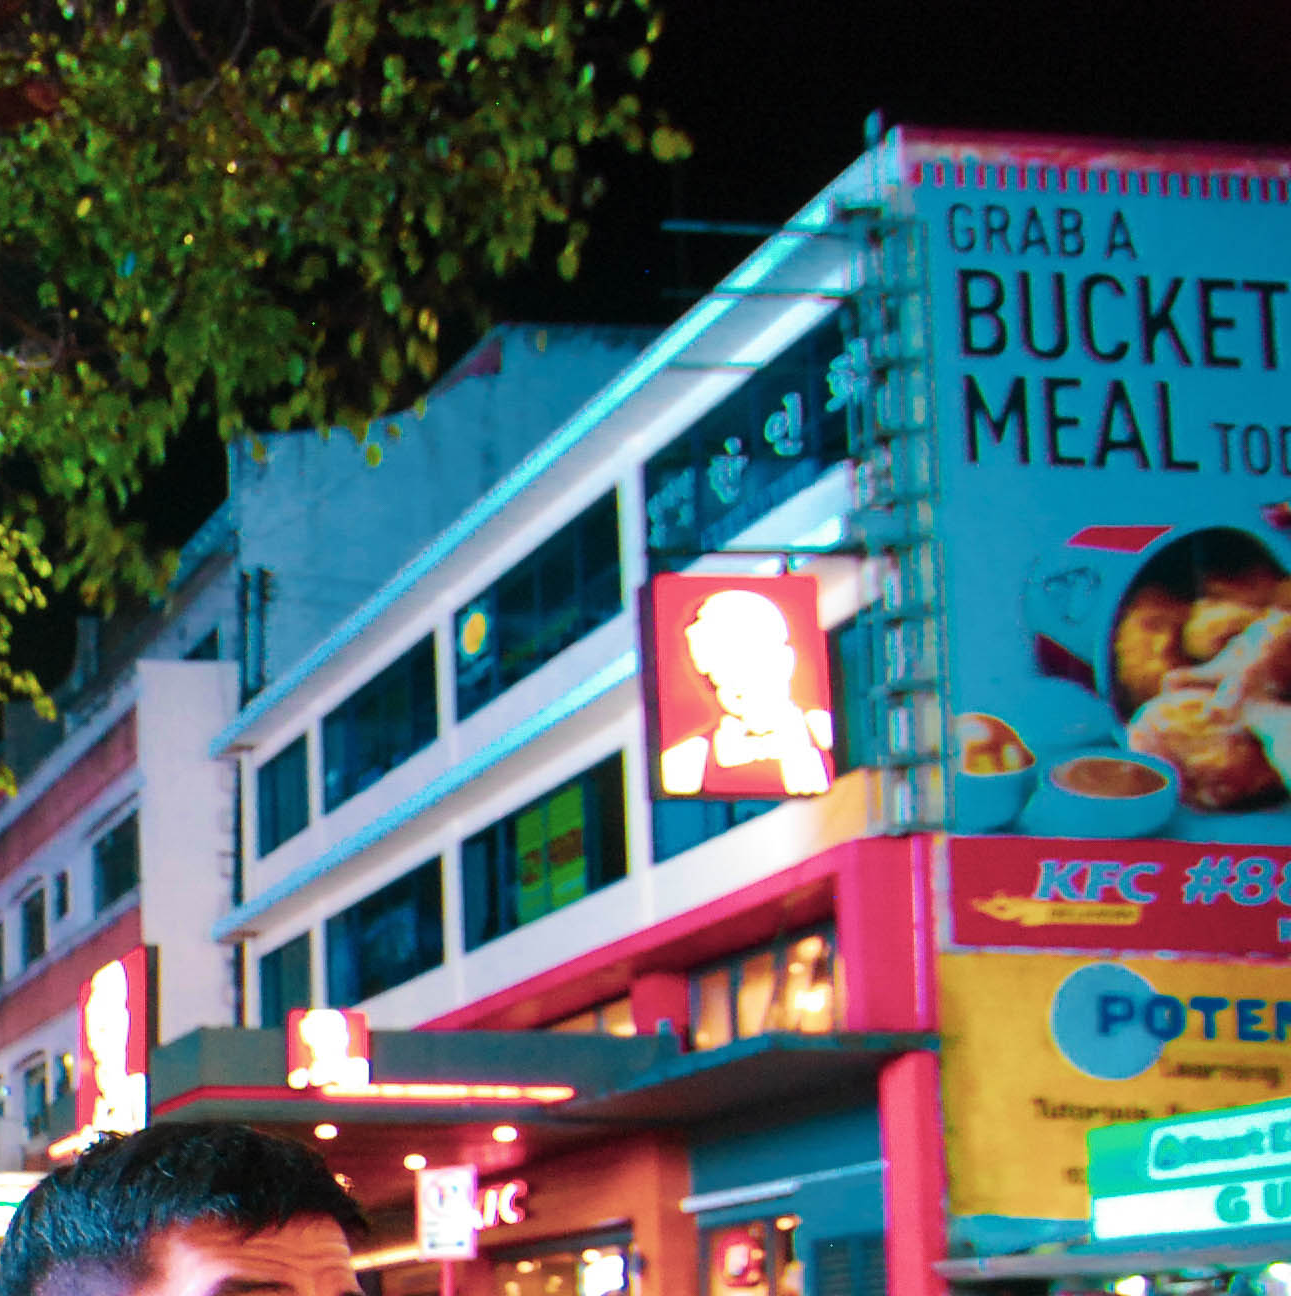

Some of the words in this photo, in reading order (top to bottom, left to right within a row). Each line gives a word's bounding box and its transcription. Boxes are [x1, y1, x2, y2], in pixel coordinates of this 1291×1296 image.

[947, 203, 1085, 258] GRAB
[1105, 209, 1138, 260] A
[957, 268, 1289, 371] BUCKET
[963, 374, 1200, 474] MEAL
[1032, 858, 1163, 904] KFC
